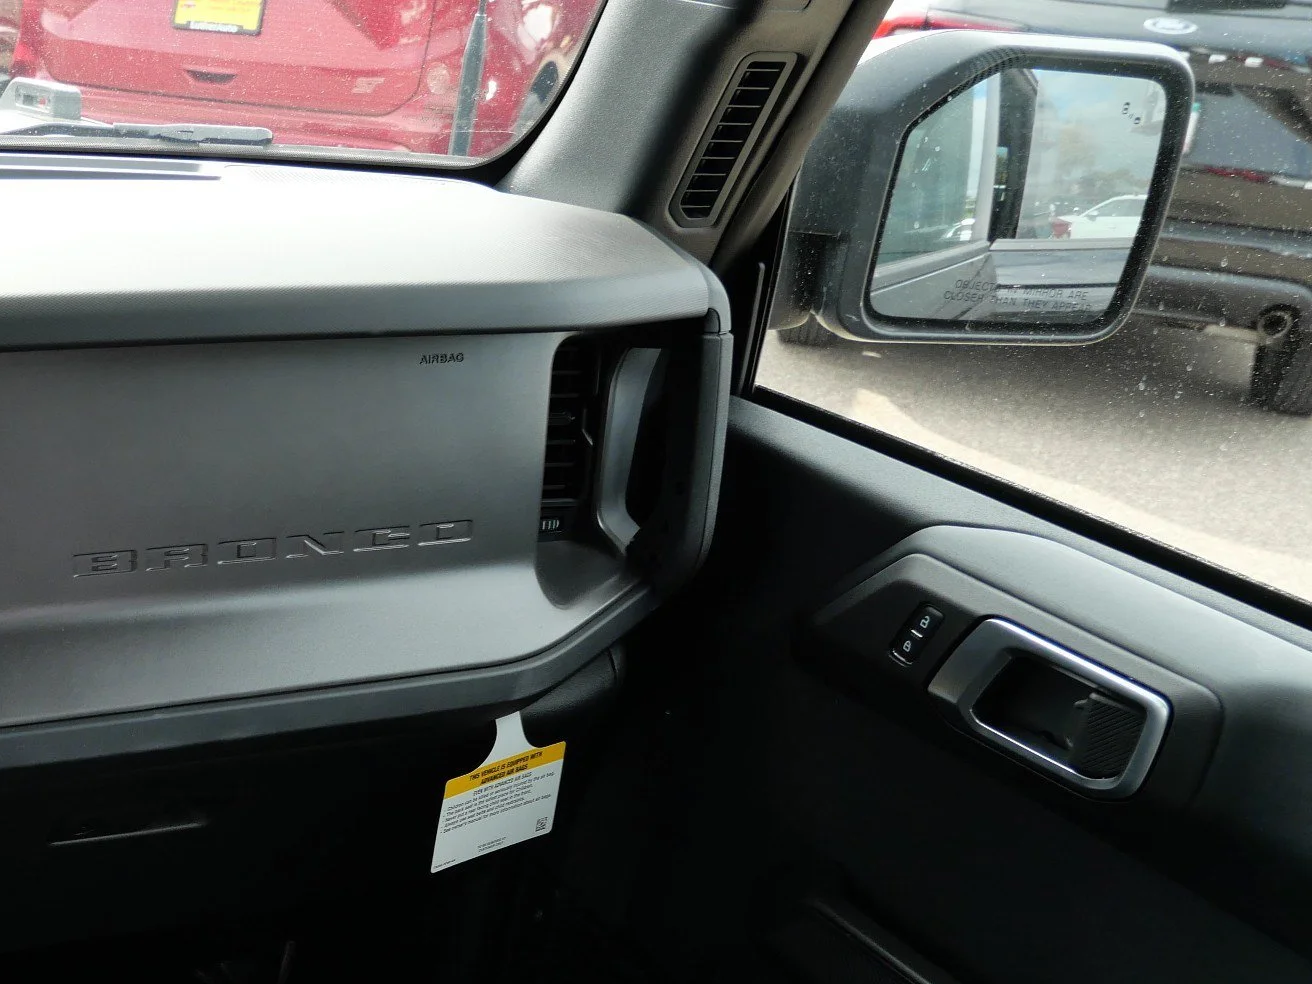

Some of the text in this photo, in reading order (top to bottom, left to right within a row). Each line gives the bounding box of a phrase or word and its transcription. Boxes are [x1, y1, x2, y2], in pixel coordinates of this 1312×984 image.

[955, 280, 1001, 293] OBJECT
[419, 352, 464, 365] AIRBAG
[73, 519, 474, 578] BRONCO
[469, 773, 481, 781] THIS
[482, 766, 501, 777] VEHICLE
[507, 756, 530, 768] EQUIPPED
[530, 752, 543, 760] WITH
[481, 772, 506, 785] ADVANCED
[516, 764, 529, 773] BAGS
